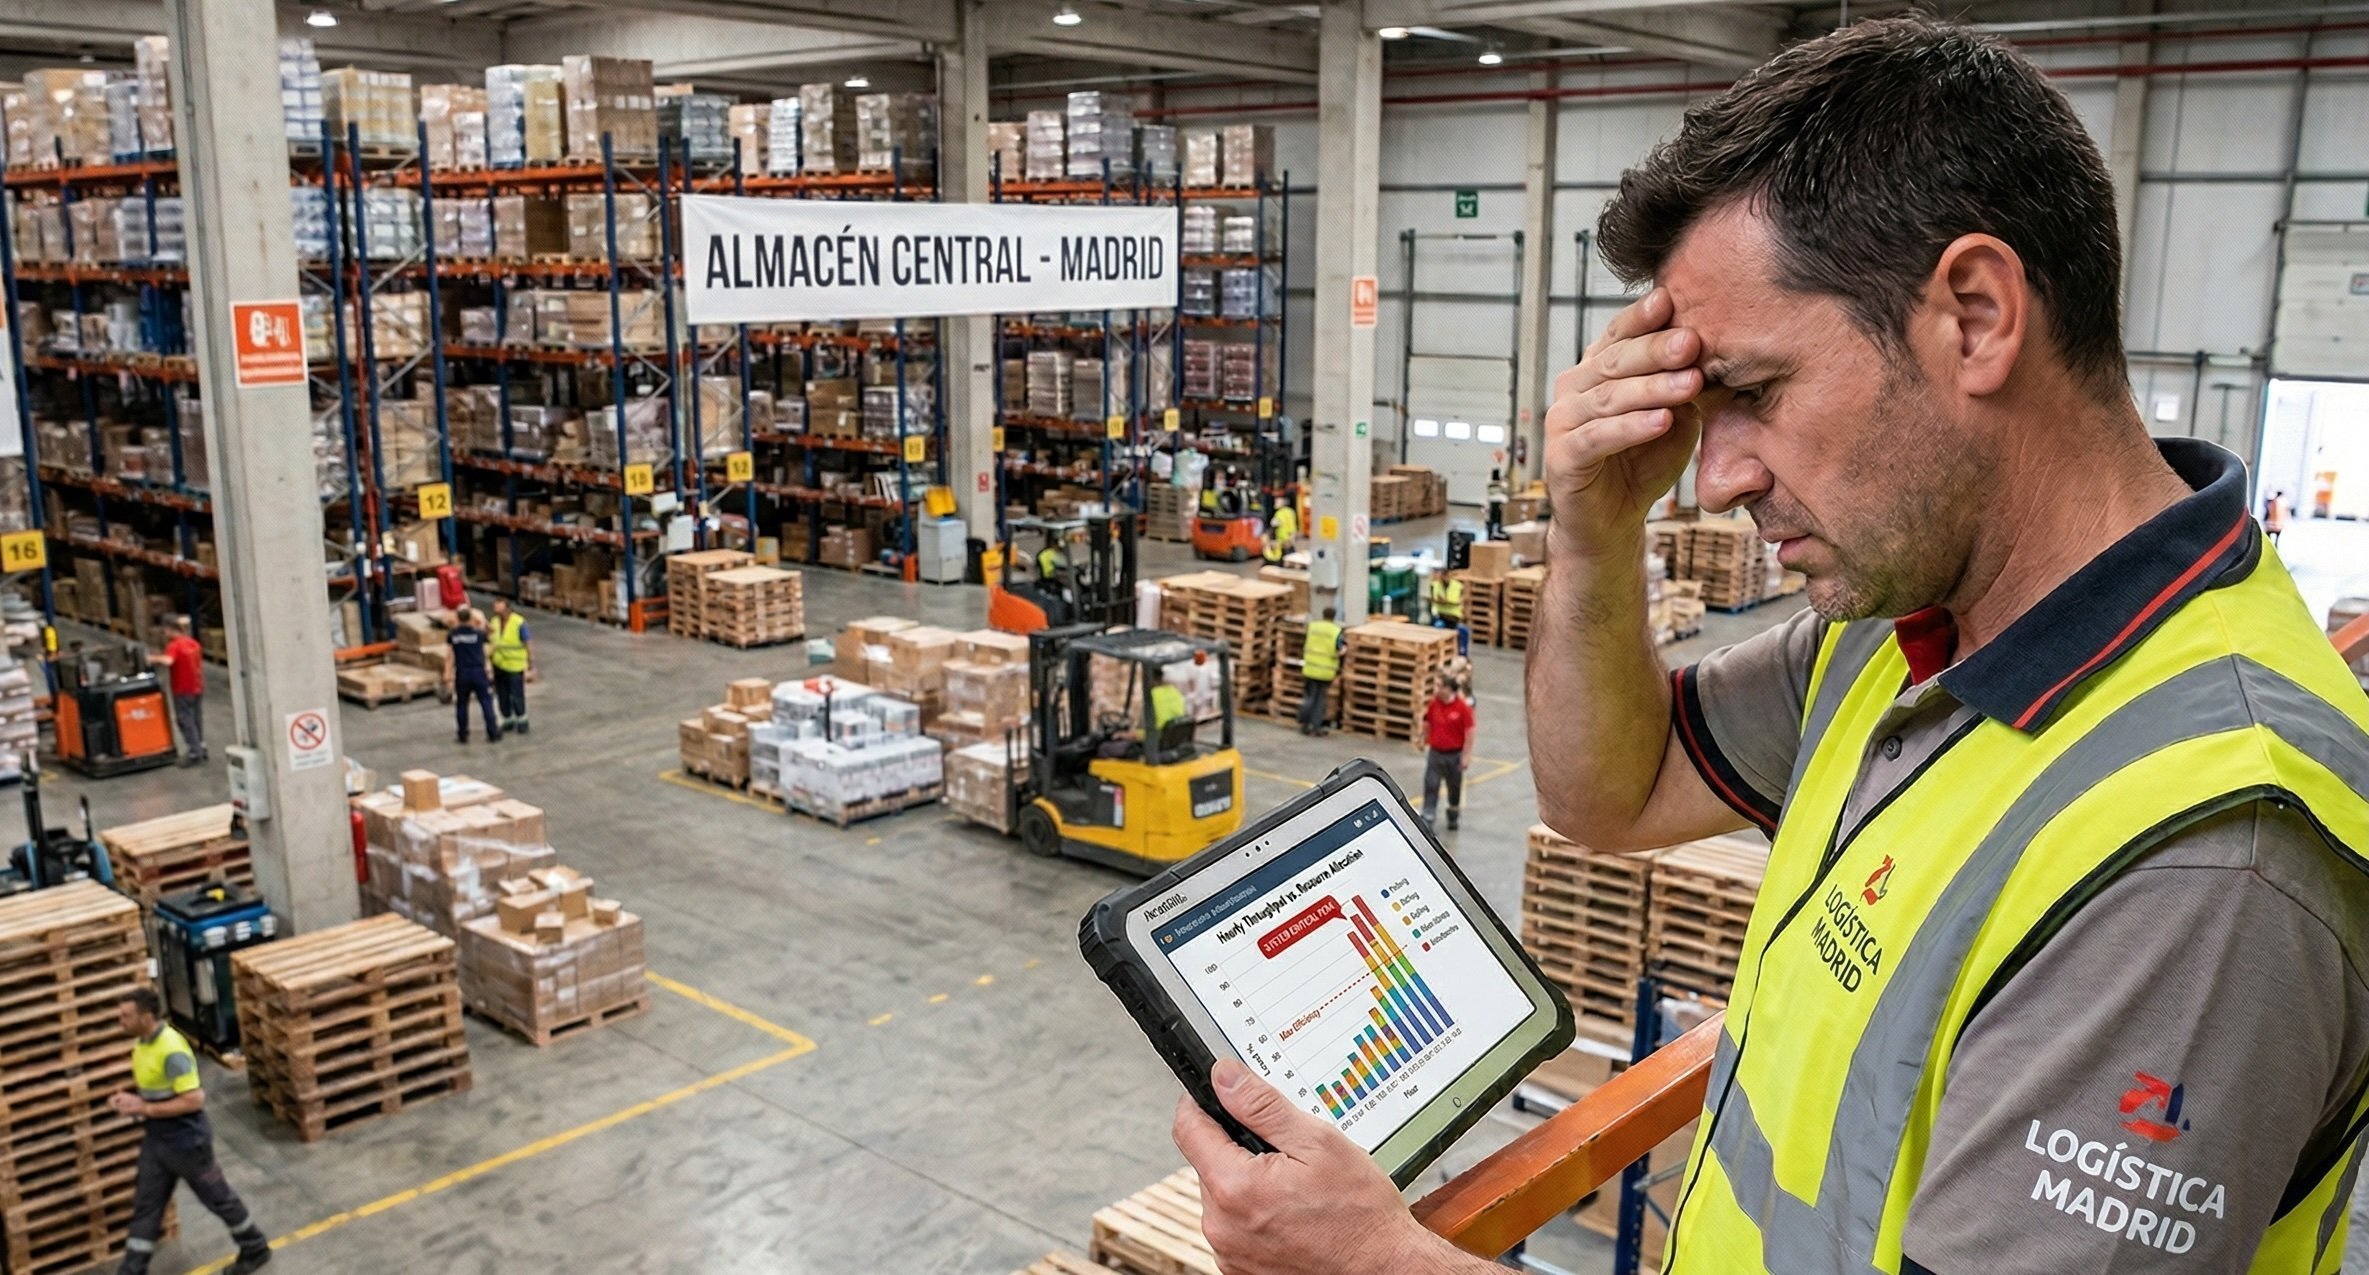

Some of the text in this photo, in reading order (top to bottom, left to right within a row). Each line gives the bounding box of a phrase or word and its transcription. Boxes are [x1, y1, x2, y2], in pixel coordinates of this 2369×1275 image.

[706, 225, 1164, 288] ALMACÉN CENTRAL - MADRID
[427, 493, 446, 510] 12
[9, 541, 38, 561] 16
[1811, 916, 1862, 993] MADRID
[1825, 884, 1882, 976] LOGÍSTICA
[2025, 1119, 2225, 1219] LOGÍSTICA
[2031, 1169, 2196, 1254] MADRID
